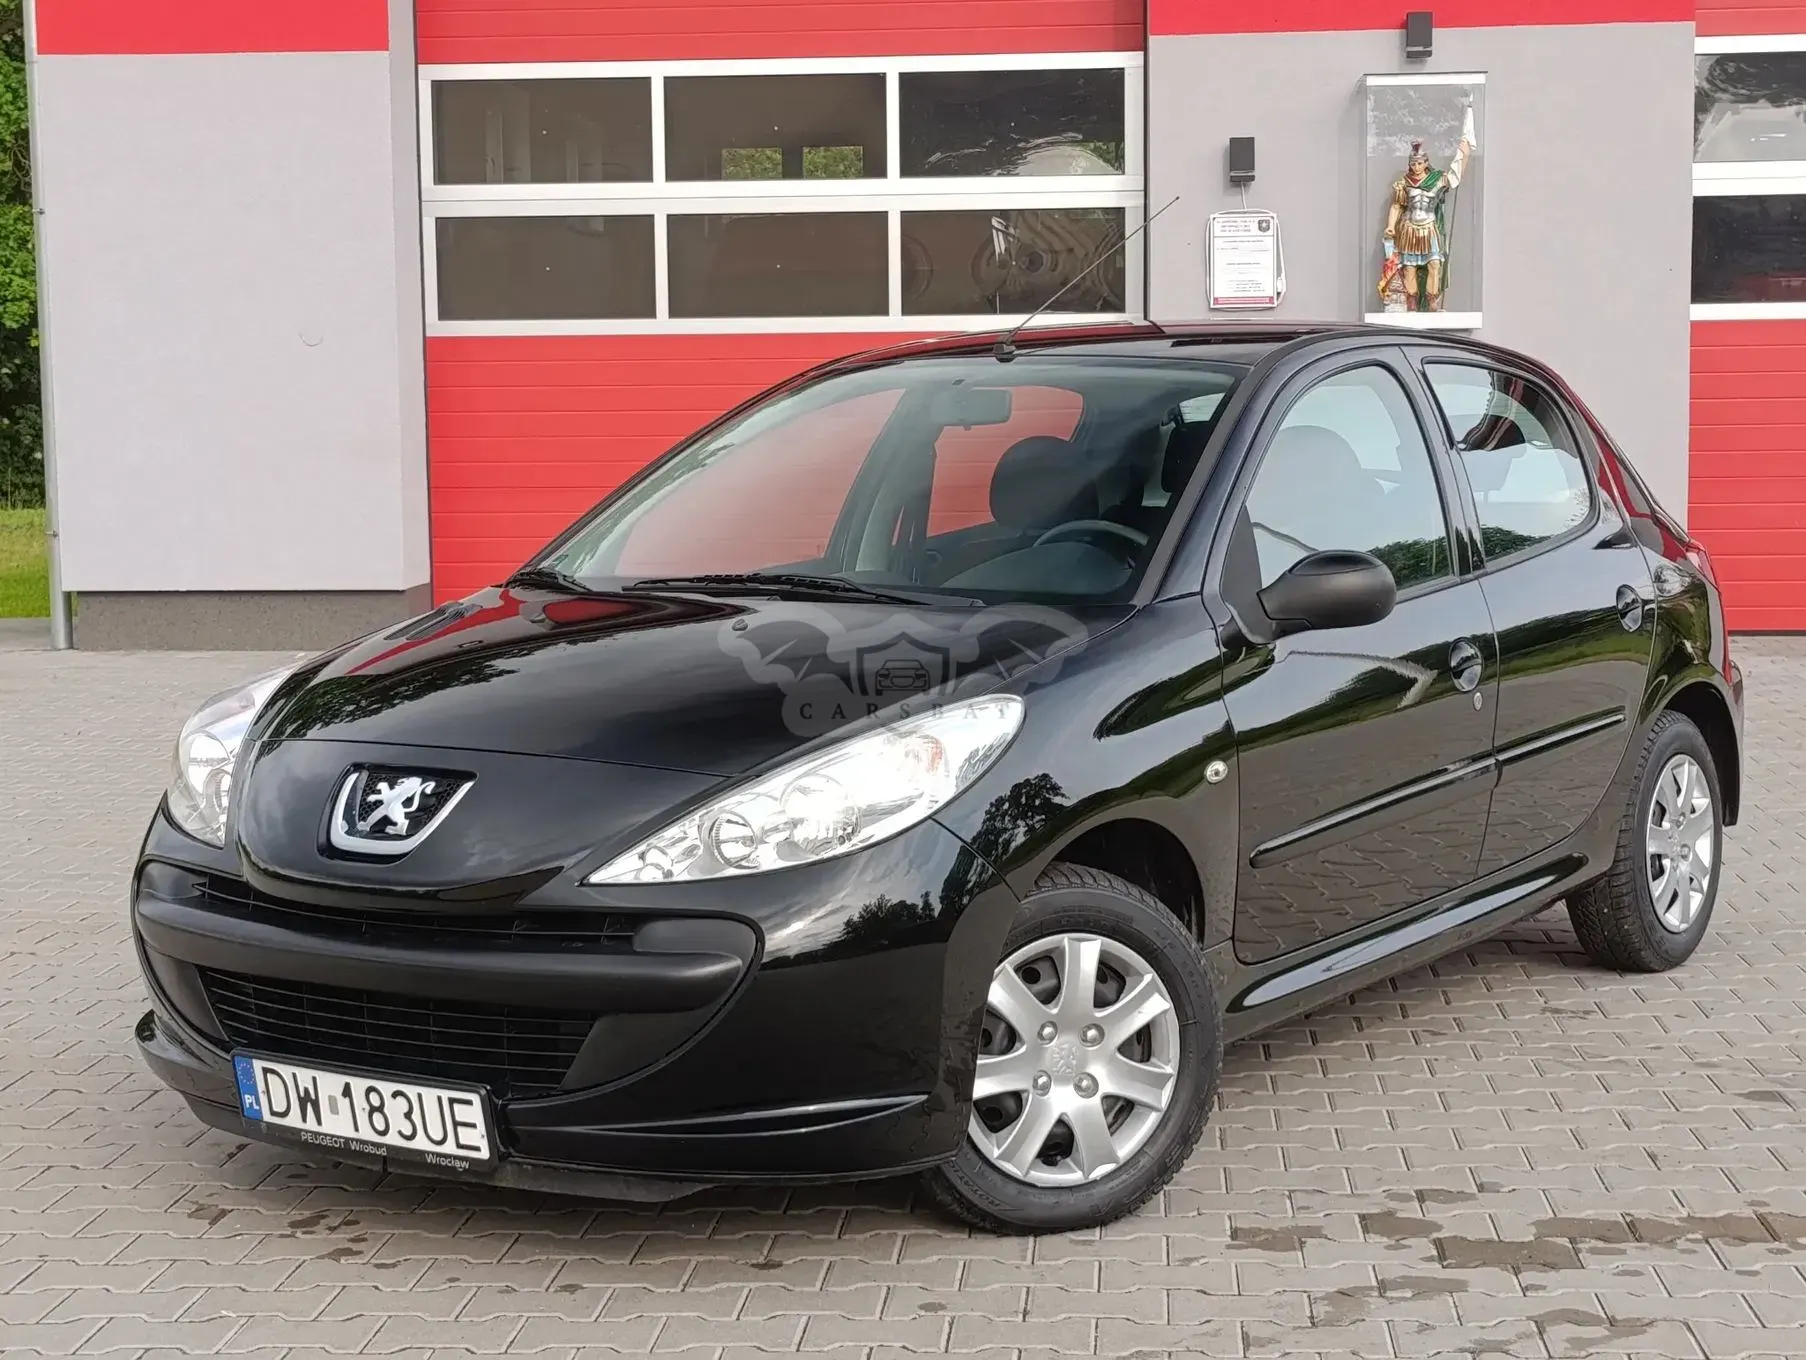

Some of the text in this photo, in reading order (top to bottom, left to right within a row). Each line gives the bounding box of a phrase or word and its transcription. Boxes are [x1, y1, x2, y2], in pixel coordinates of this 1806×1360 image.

[244, 1094, 260, 1110] PL
[261, 1066, 482, 1153] DW 183UE
[300, 1131, 346, 1149] PEUGEOT
[350, 1140, 388, 1156] Wrobud
